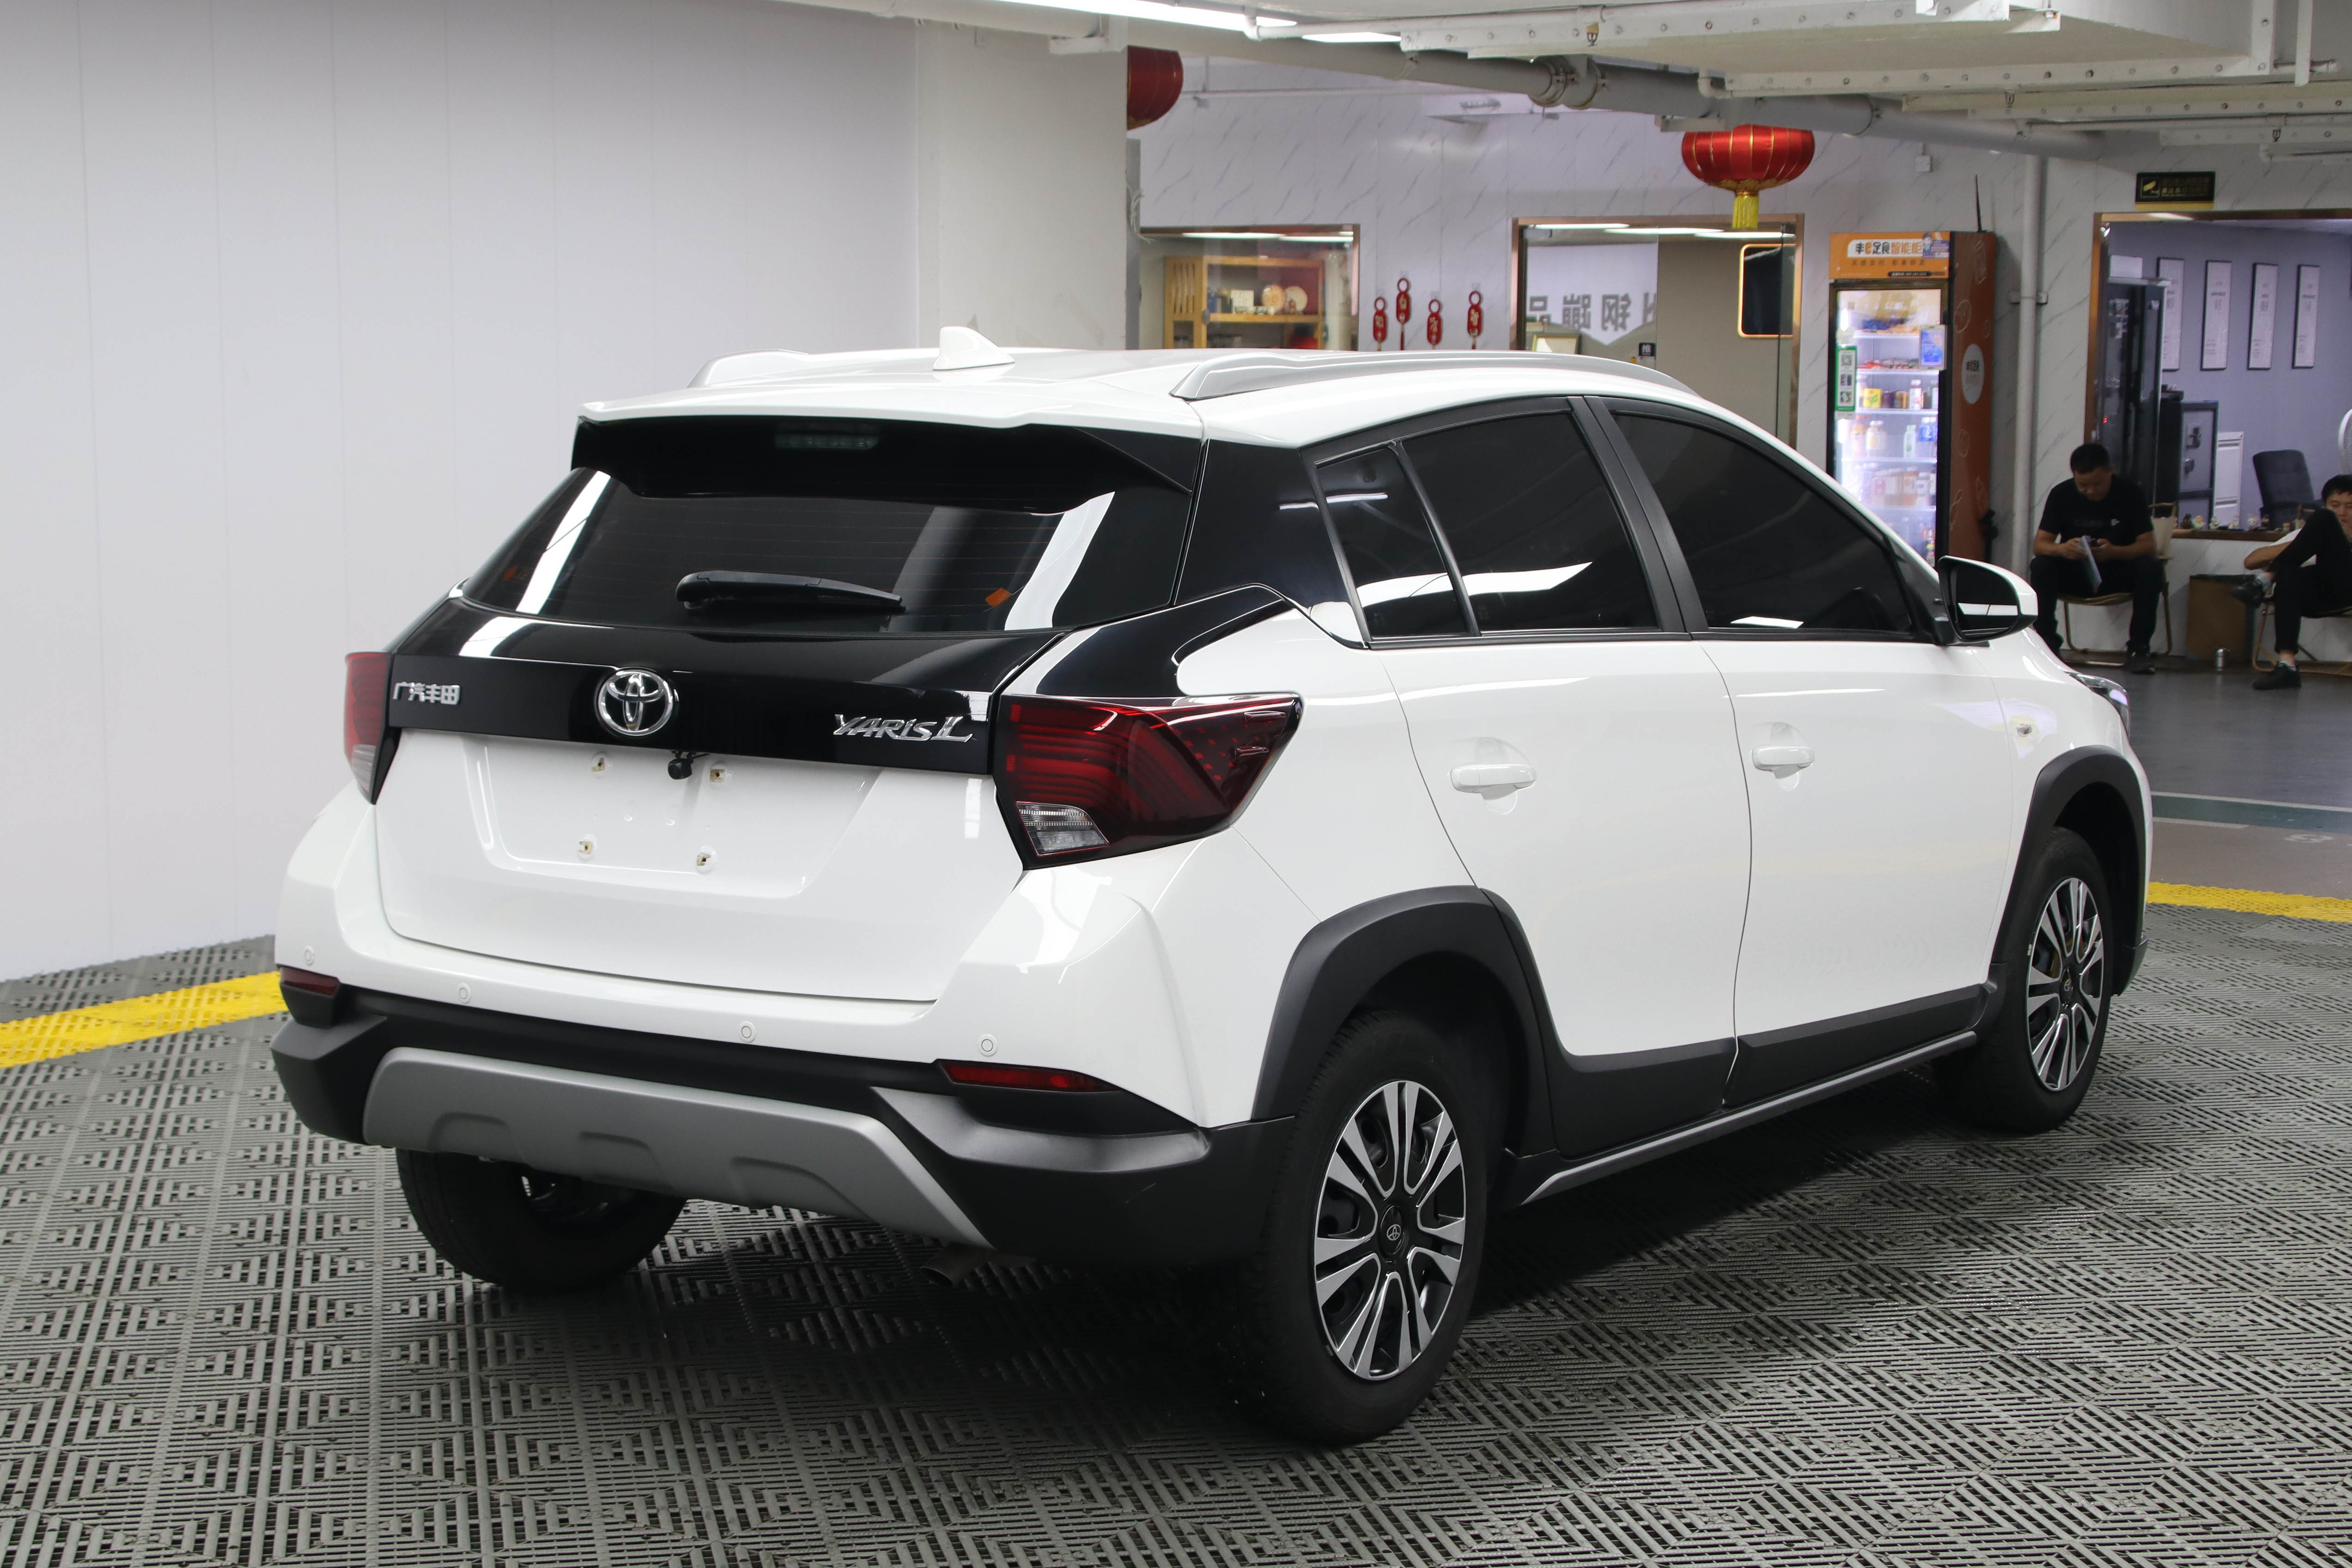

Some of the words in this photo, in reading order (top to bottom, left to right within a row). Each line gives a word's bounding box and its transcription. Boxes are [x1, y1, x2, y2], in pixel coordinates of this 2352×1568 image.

[393, 682, 460, 705] 广汽丰田
[833, 714, 937, 741] YARIS
[930, 717, 973, 742] L
